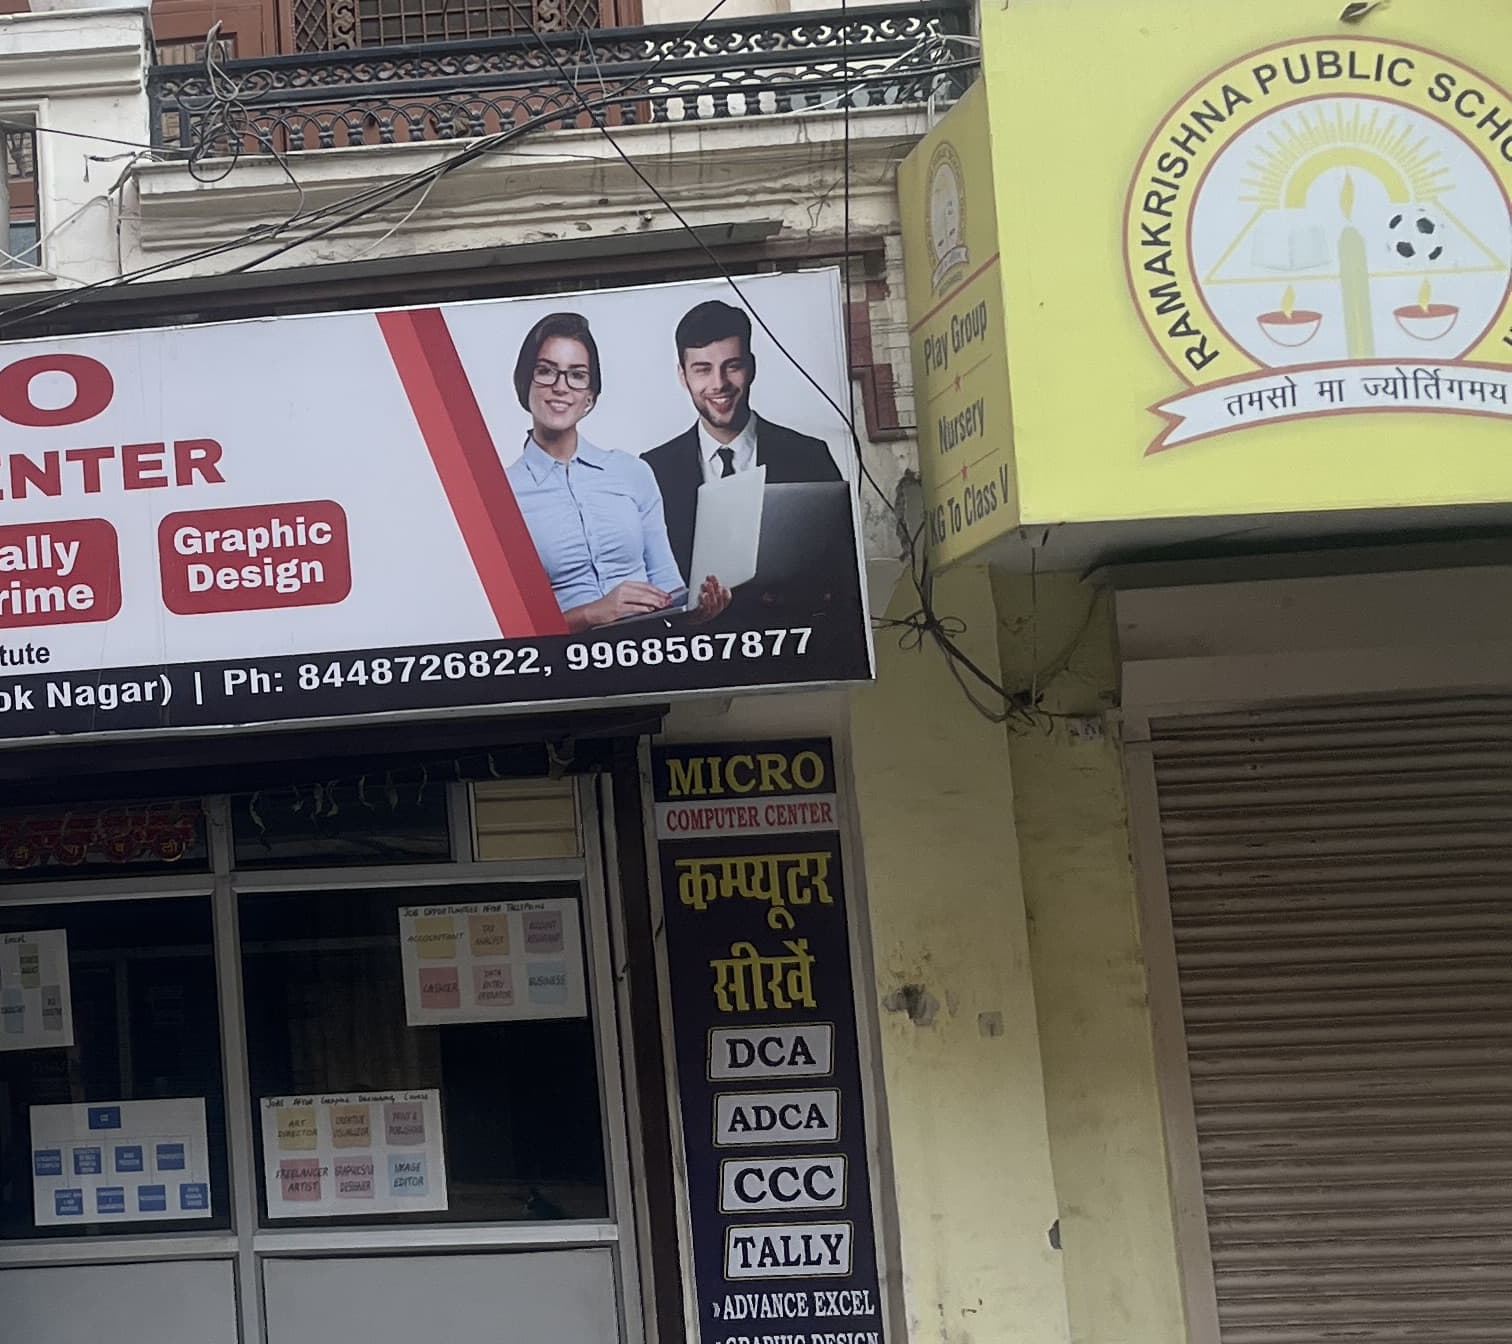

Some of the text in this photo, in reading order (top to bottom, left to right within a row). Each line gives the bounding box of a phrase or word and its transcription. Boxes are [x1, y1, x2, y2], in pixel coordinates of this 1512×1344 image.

[1140, 83, 1254, 371] RAMAKRISHNA
[1251, 49, 1416, 95] PUBLIC
[923, 300, 988, 376] Play Group
[1224, 375, 1298, 417] तमसो
[1315, 377, 1345, 404] मा
[938, 396, 985, 456] Nursery
[929, 463, 1009, 548] KG To Class V
[172, 518, 333, 561] Graphic
[187, 555, 326, 597] Design
[46, 670, 174, 715] Nagar)
[223, 663, 285, 698] Ph:
[297, 644, 553, 693] 8448726822,
[565, 625, 815, 675] 9968567877
[665, 750, 826, 797] MICRO
[666, 801, 834, 833] COMPUTER CENTER
[726, 1035, 817, 1070] DCA
[727, 1103, 829, 1134] ADCA
[733, 1164, 837, 1204] CCC
[733, 1232, 844, 1269] TALLY
[723, 1289, 875, 1322] ADVANCE EXCEL
